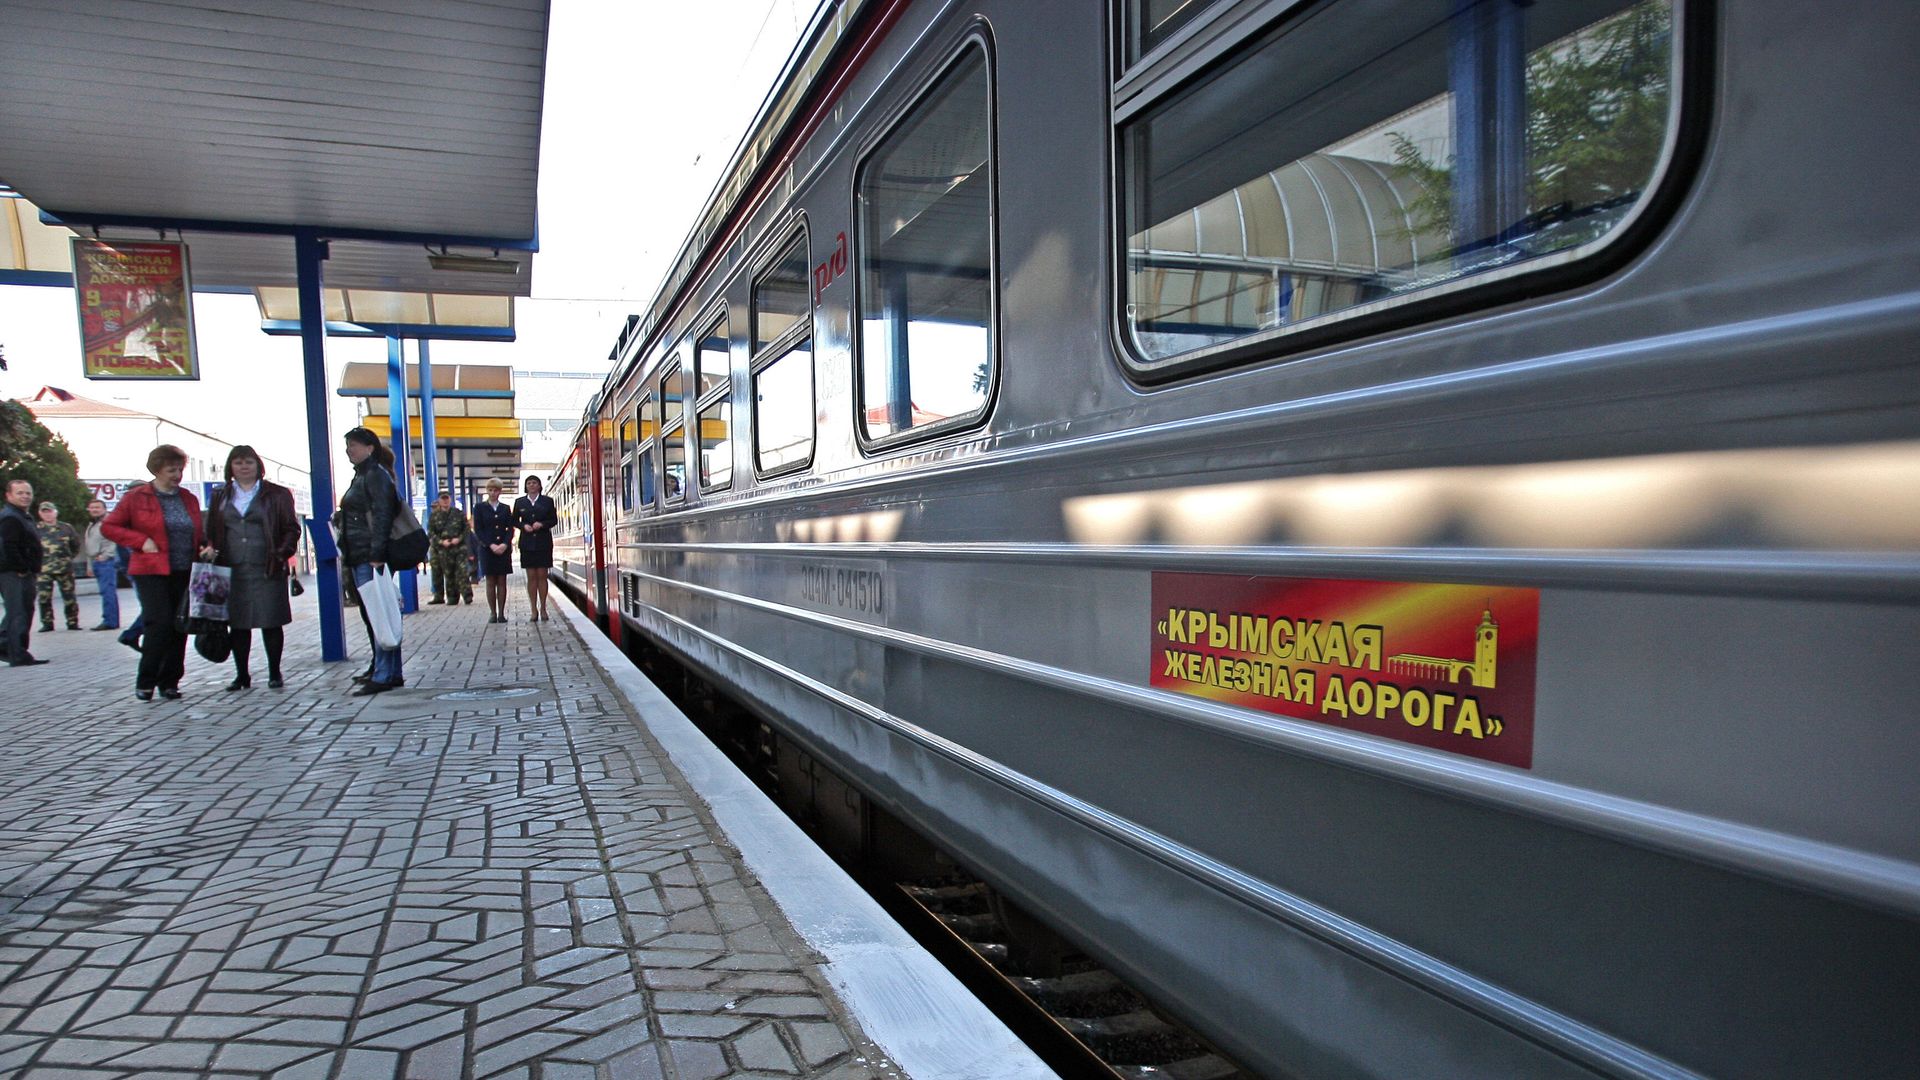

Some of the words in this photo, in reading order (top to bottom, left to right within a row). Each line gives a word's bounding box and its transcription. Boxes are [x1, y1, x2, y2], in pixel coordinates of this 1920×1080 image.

[86, 290, 101, 307] 9
[1157, 608, 1384, 672] «КРЫМСКАЯ
[1163, 649, 1316, 706] ЖЕЛЕЗНАЯ
[1321, 675, 1505, 740] ДОРОГА»
